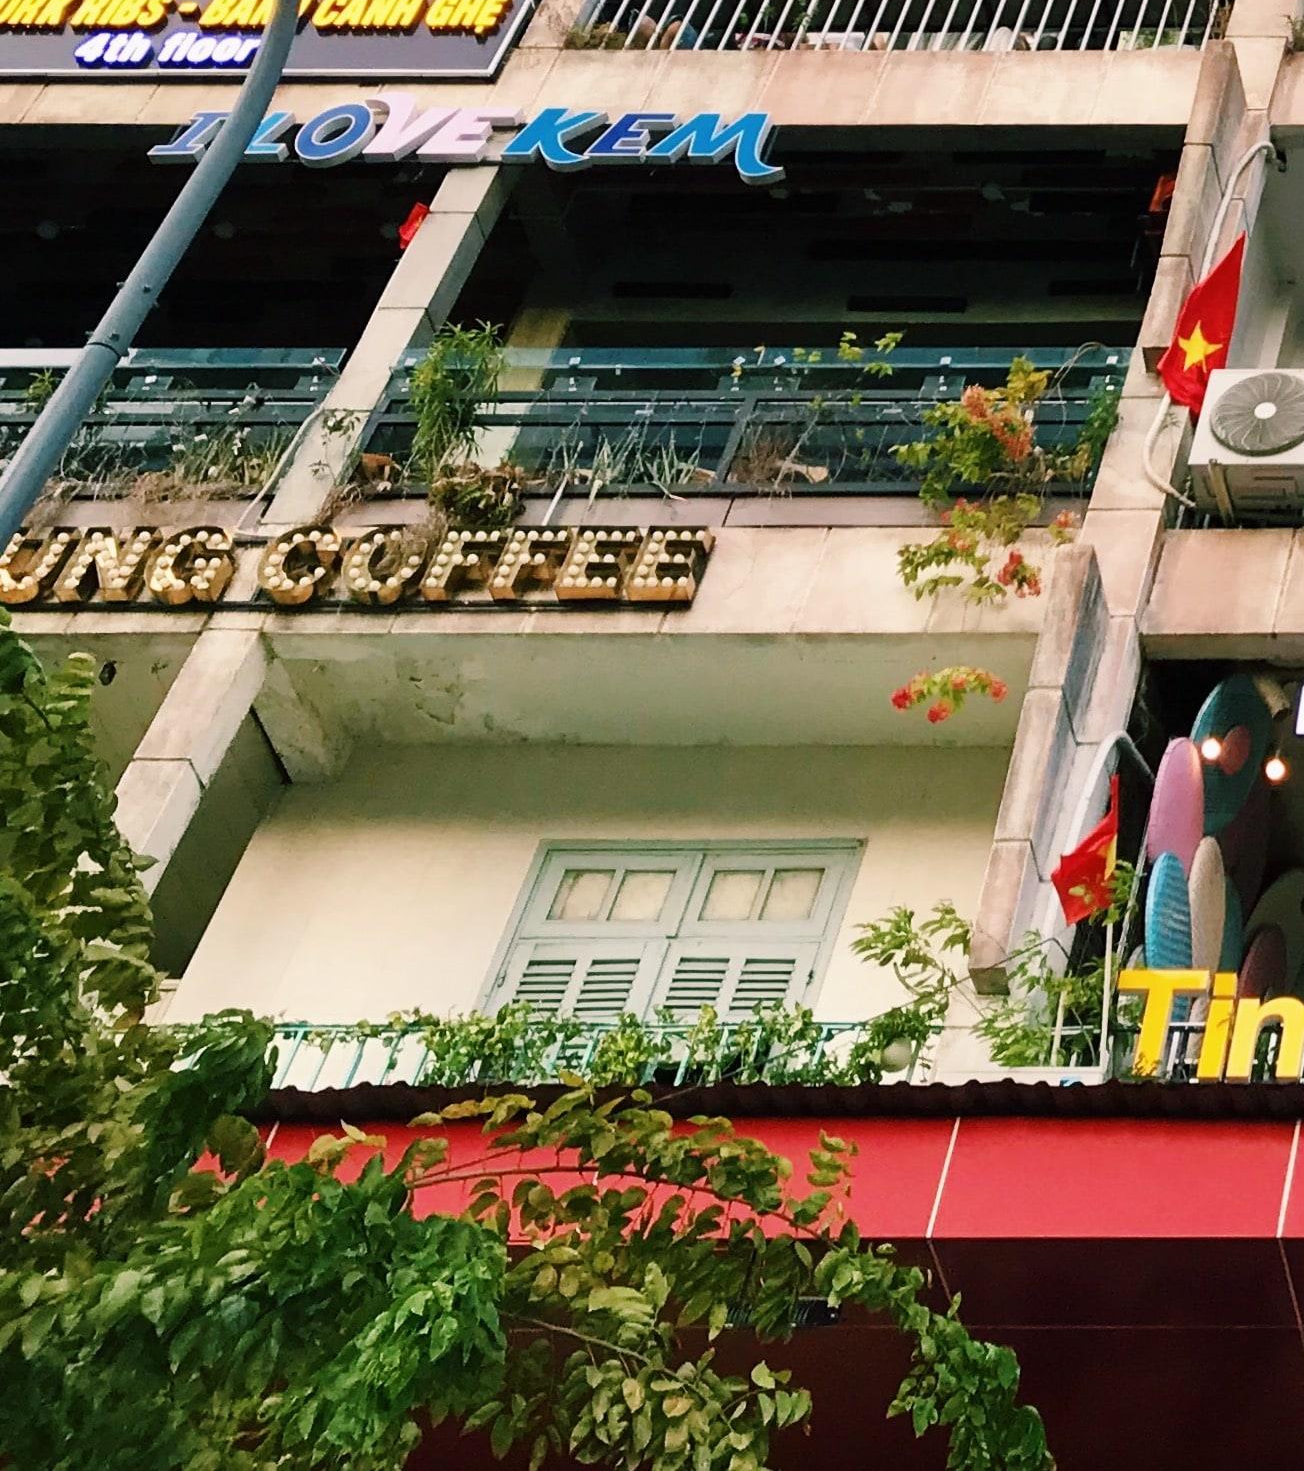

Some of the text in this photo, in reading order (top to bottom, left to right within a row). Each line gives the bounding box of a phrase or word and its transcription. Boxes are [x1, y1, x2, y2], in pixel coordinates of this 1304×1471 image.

[75, 32, 262, 63] 4th floor
[242, 93, 516, 161] LOVE
[500, 106, 787, 183] KEM
[257, 526, 713, 604] COFFEE
